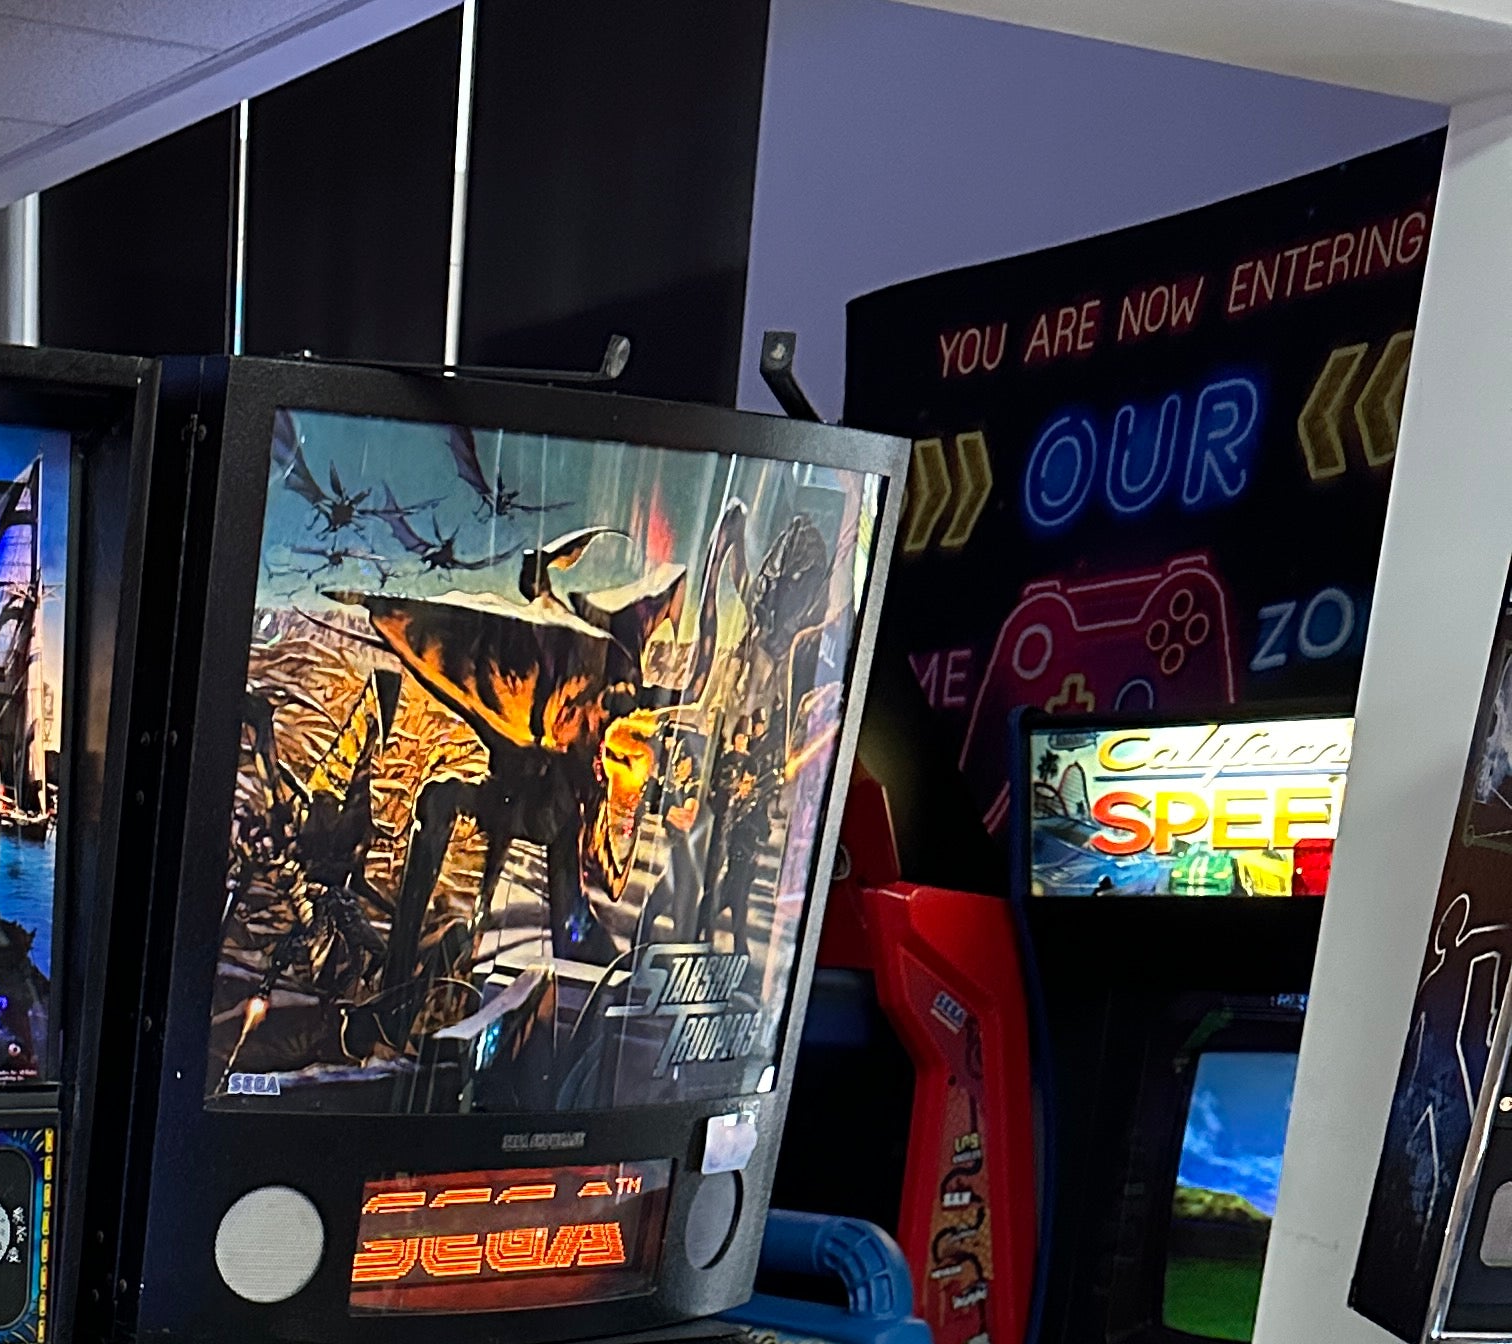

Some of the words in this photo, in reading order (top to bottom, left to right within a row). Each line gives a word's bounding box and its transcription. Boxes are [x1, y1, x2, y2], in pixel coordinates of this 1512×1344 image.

[939, 323, 1008, 378] YOU
[1024, 299, 1101, 363] ARE
[1117, 275, 1206, 344] NOW
[1227, 210, 1428, 315] ENTERING
[1024, 377, 1259, 528] OUR
[605, 943, 751, 1018] STARSHIP
[653, 1001, 763, 1079] TROOPERS
[228, 1073, 280, 1096] SEGA
